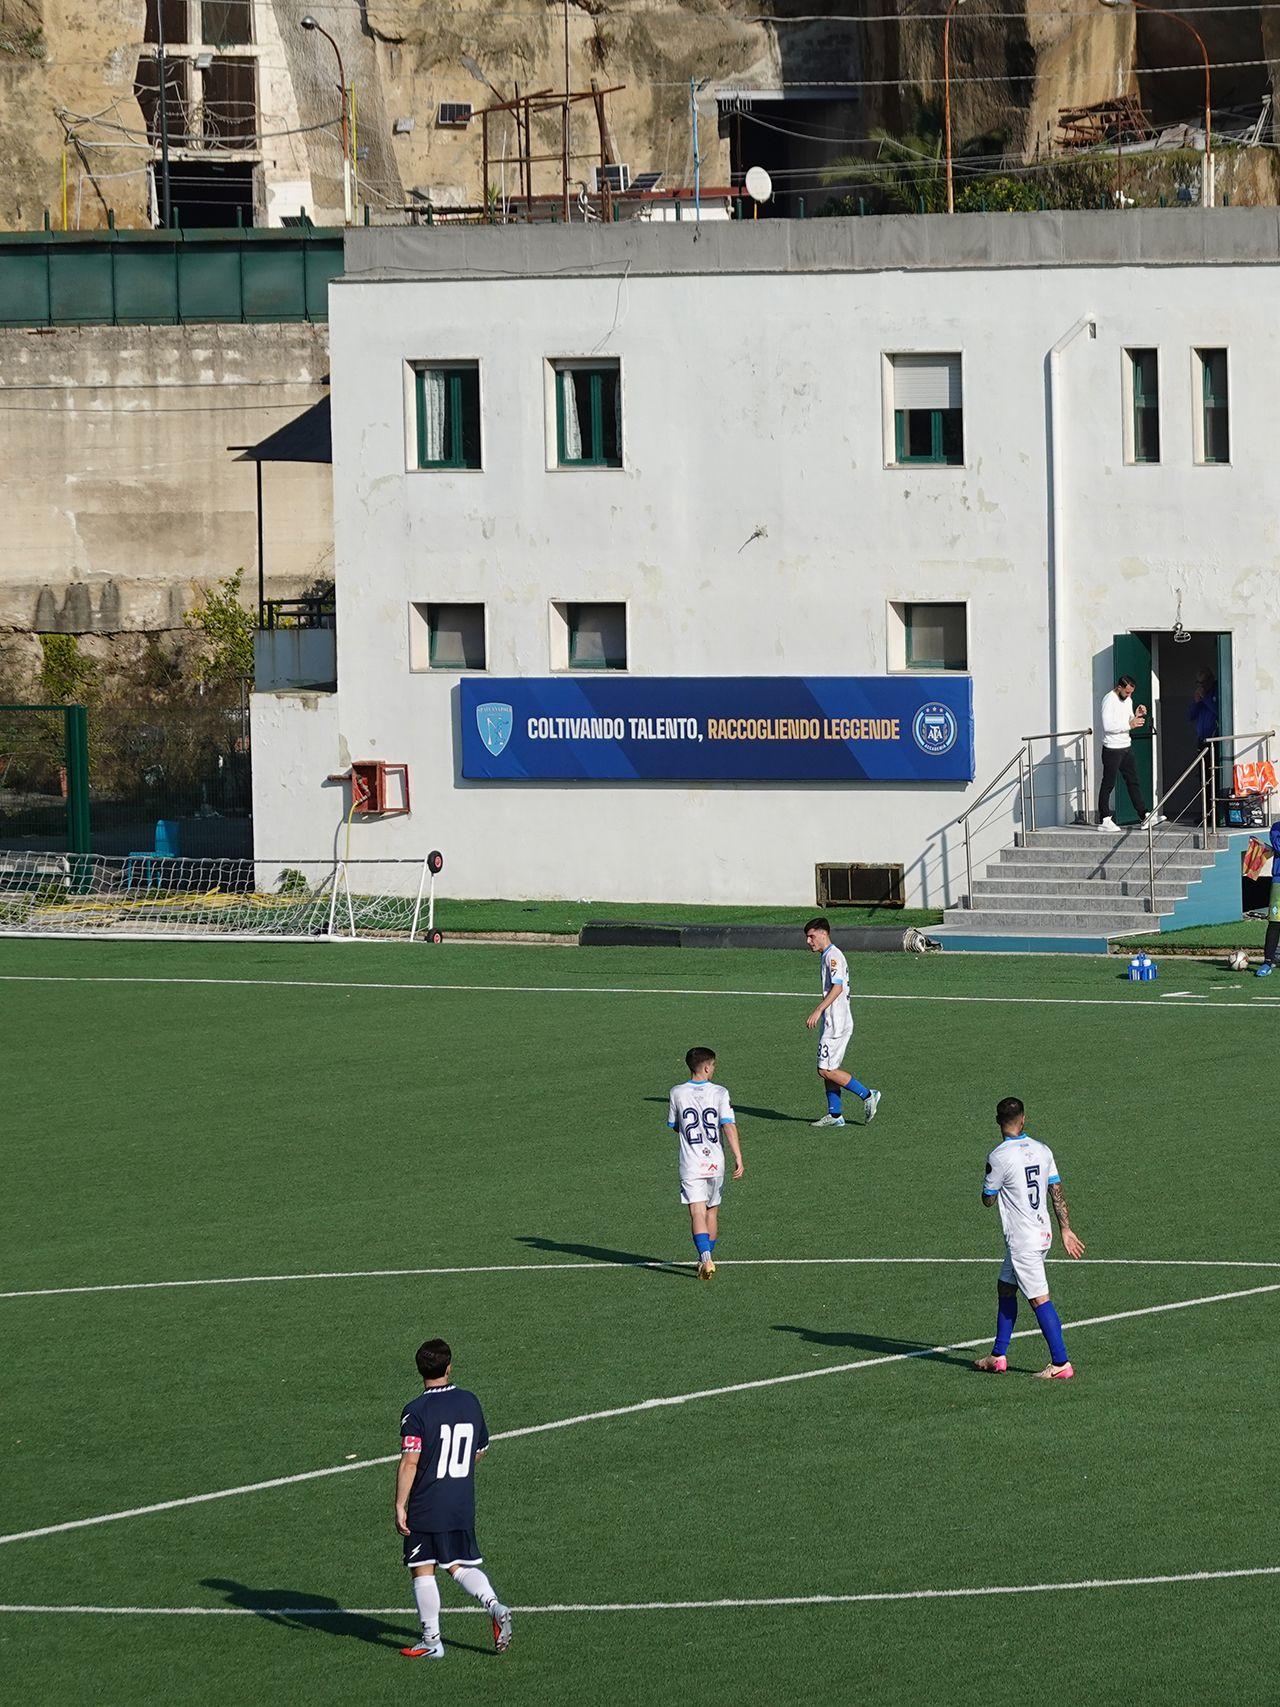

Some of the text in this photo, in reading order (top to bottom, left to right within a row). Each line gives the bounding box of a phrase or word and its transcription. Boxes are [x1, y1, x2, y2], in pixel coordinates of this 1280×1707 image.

[527, 717, 900, 743] COLTIVANDO TALENTO, RACCOGLIENDO LEGGENDE
[683, 1107, 718, 1145] 26
[1024, 1164, 1041, 1210] 5
[436, 1422, 475, 1479] 10
